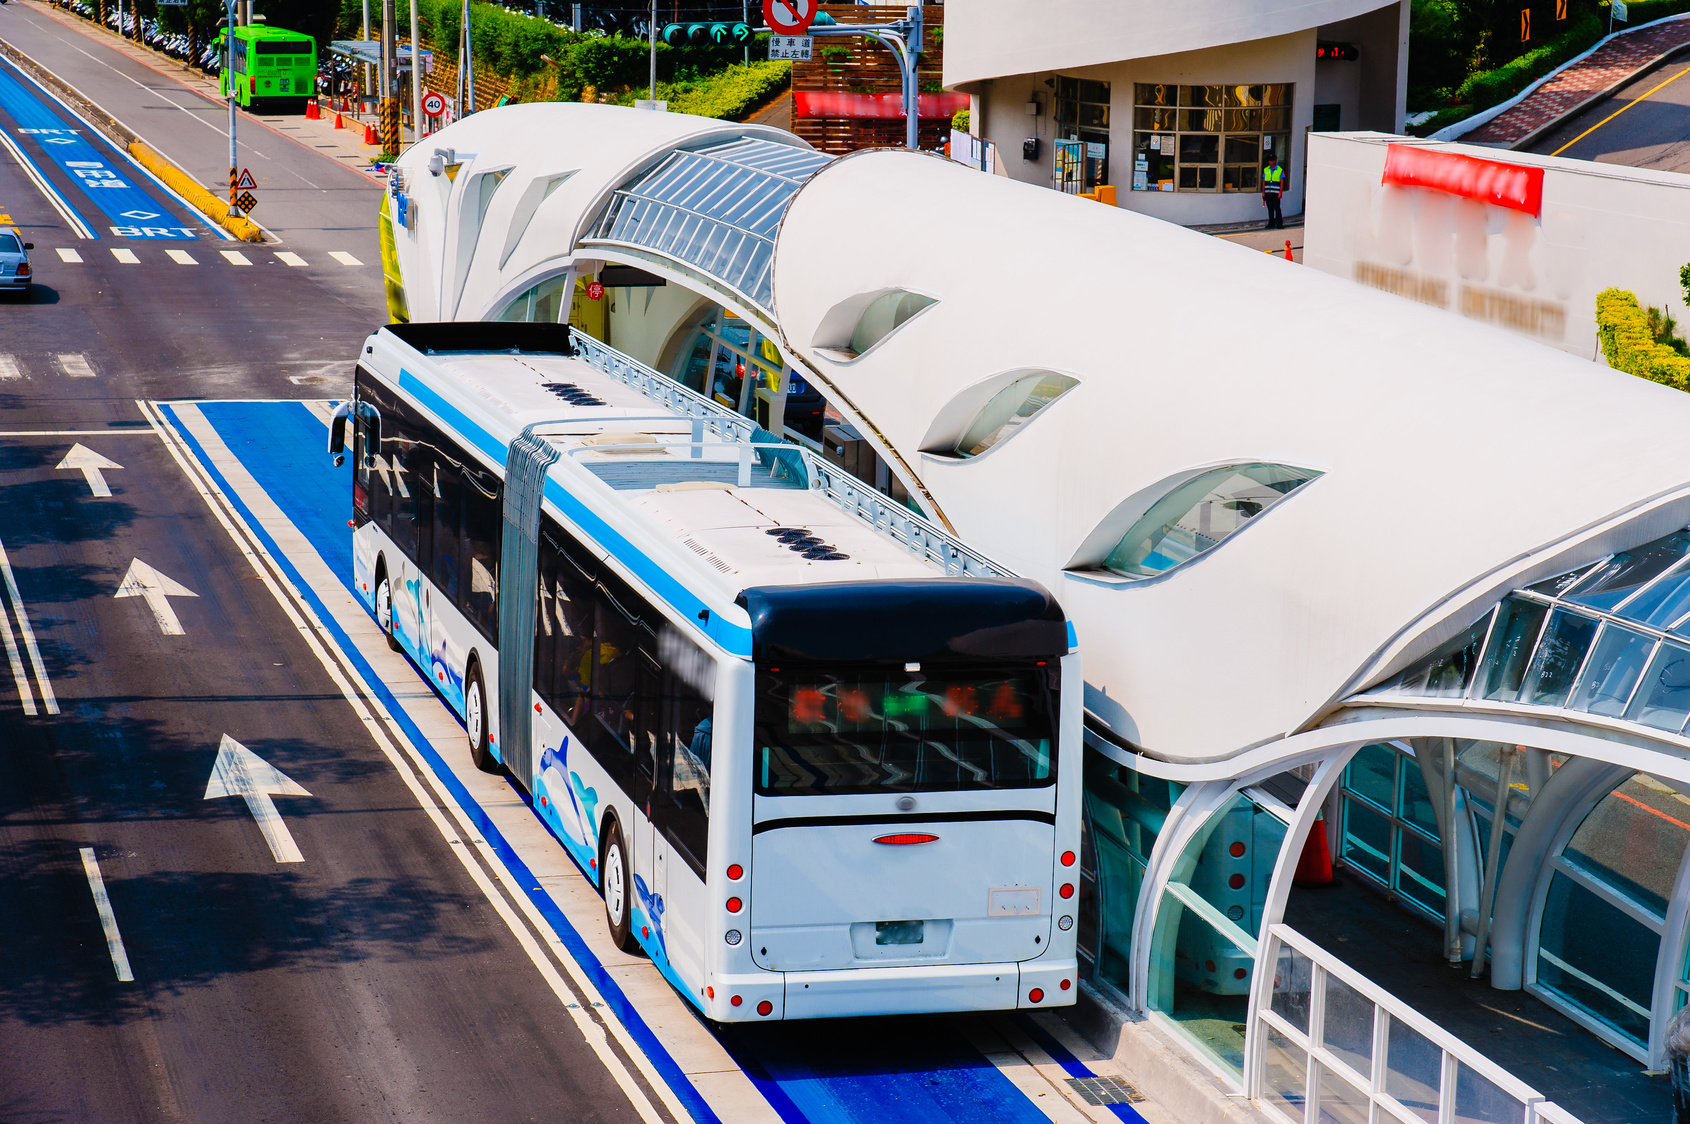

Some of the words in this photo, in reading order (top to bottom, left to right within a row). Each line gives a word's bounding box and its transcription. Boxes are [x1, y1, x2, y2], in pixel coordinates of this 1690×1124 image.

[772, 38, 811, 48] 慢車道
[770, 49, 810, 59] 禁止左轉
[109, 226, 197, 238] BRT
[589, 285, 602, 297] 停
